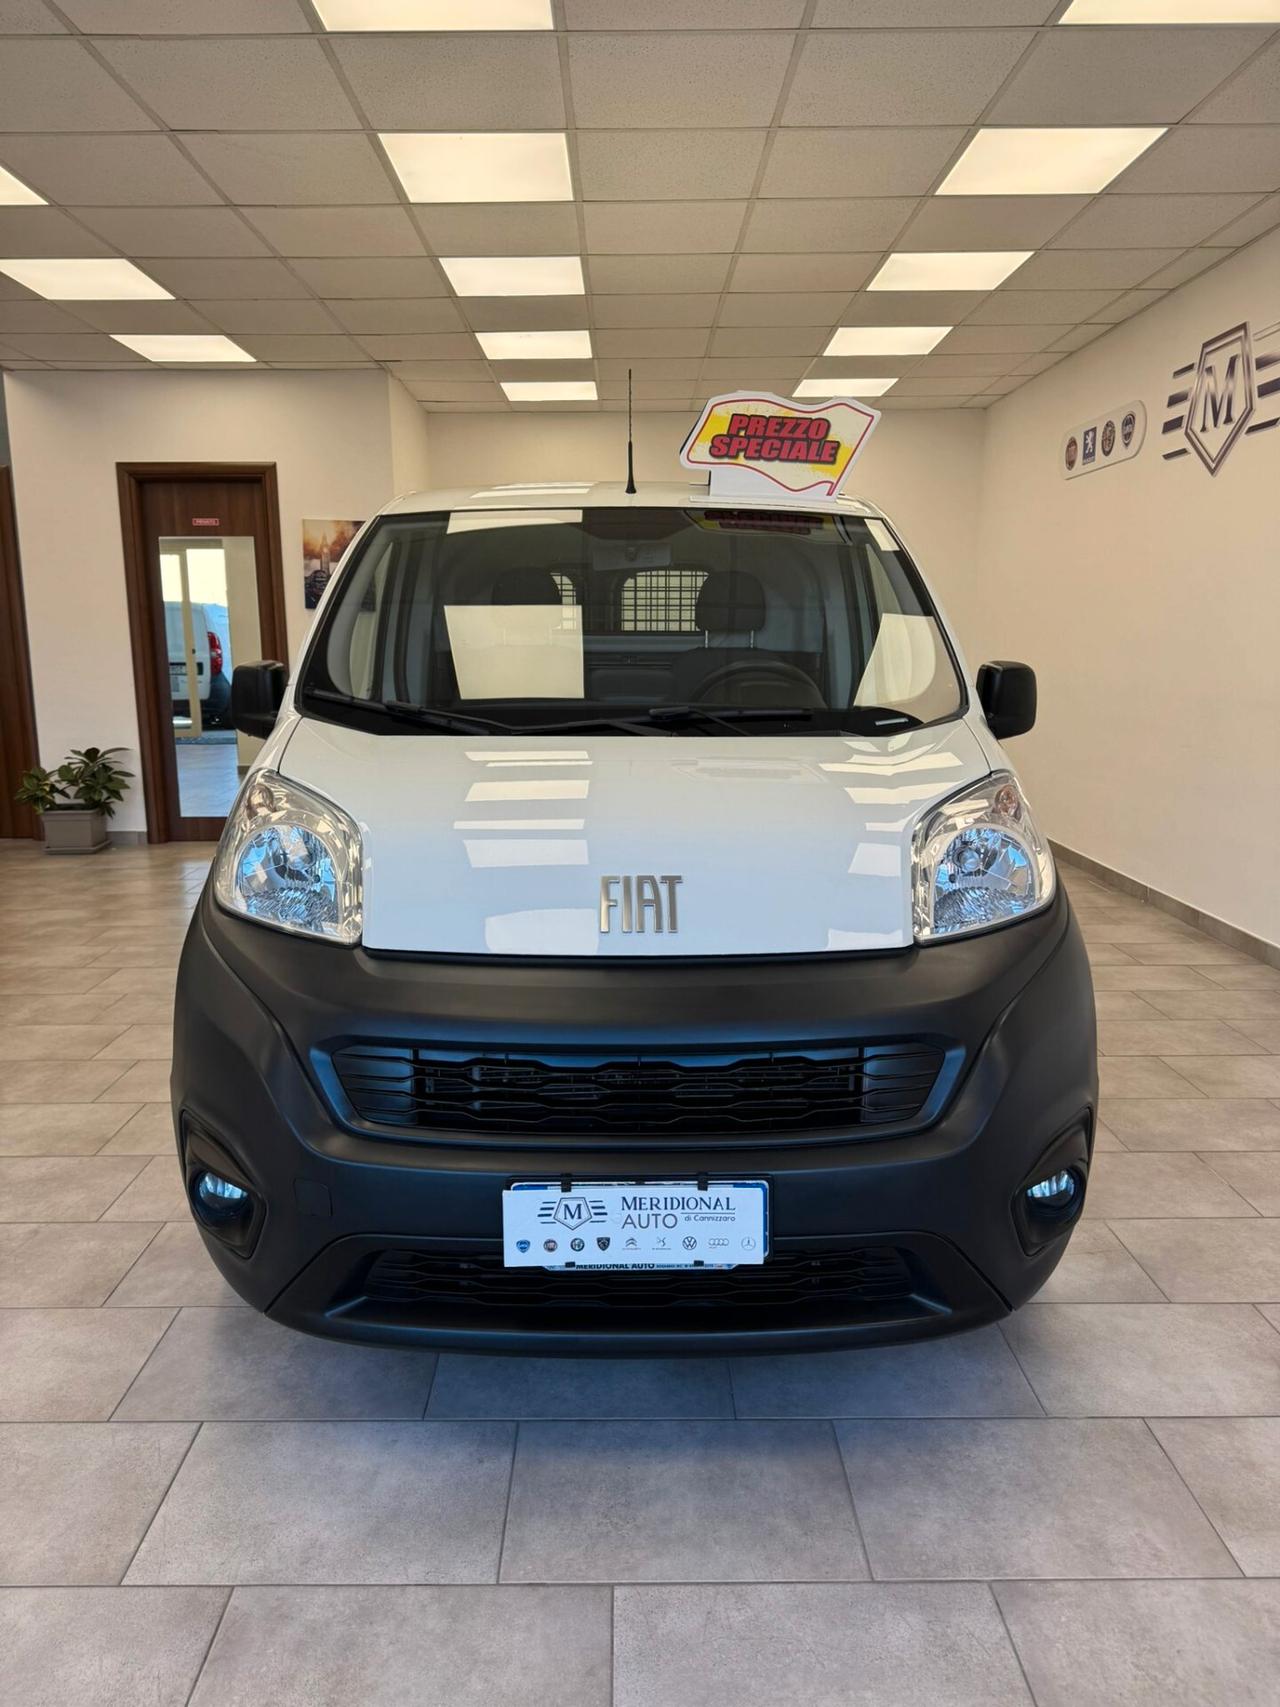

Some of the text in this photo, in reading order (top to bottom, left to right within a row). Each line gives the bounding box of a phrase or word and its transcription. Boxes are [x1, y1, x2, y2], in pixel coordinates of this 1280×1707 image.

[1200, 354, 1240, 433] M
[728, 413, 831, 440] PREZZO
[709, 434, 840, 464] SPECIALE
[600, 875, 683, 933] FIAT
[563, 1204, 582, 1220] M
[621, 1196, 736, 1211] MERIDIONAL
[621, 1213, 678, 1229] AUTO
